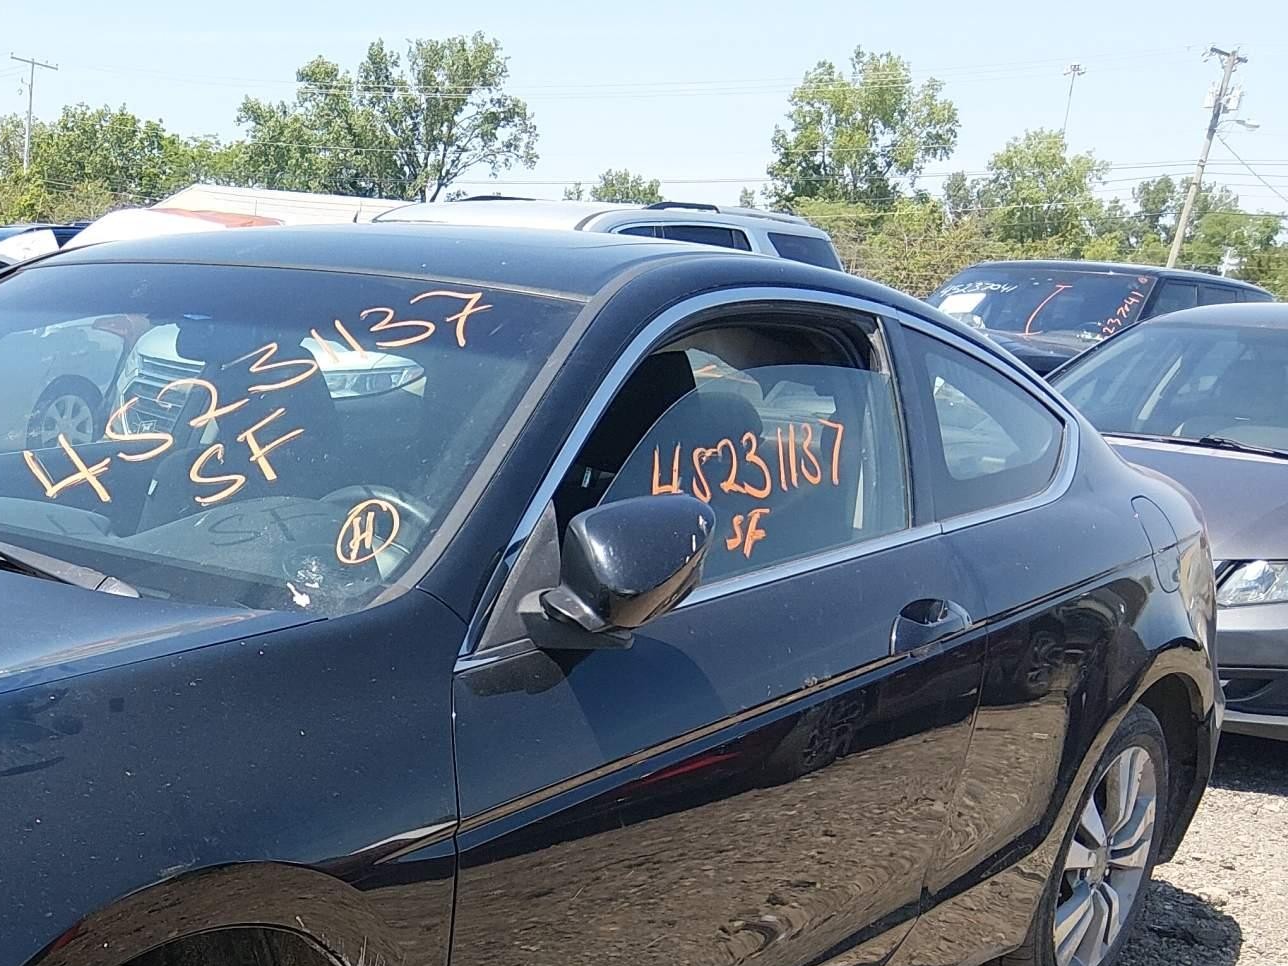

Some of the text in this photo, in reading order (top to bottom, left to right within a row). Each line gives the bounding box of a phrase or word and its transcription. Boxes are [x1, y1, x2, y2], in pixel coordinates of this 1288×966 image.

[23, 290, 493, 502] 45231137
[189, 407, 306, 506] SF
[651, 418, 844, 504] 45231137
[724, 507, 771, 559] SF
